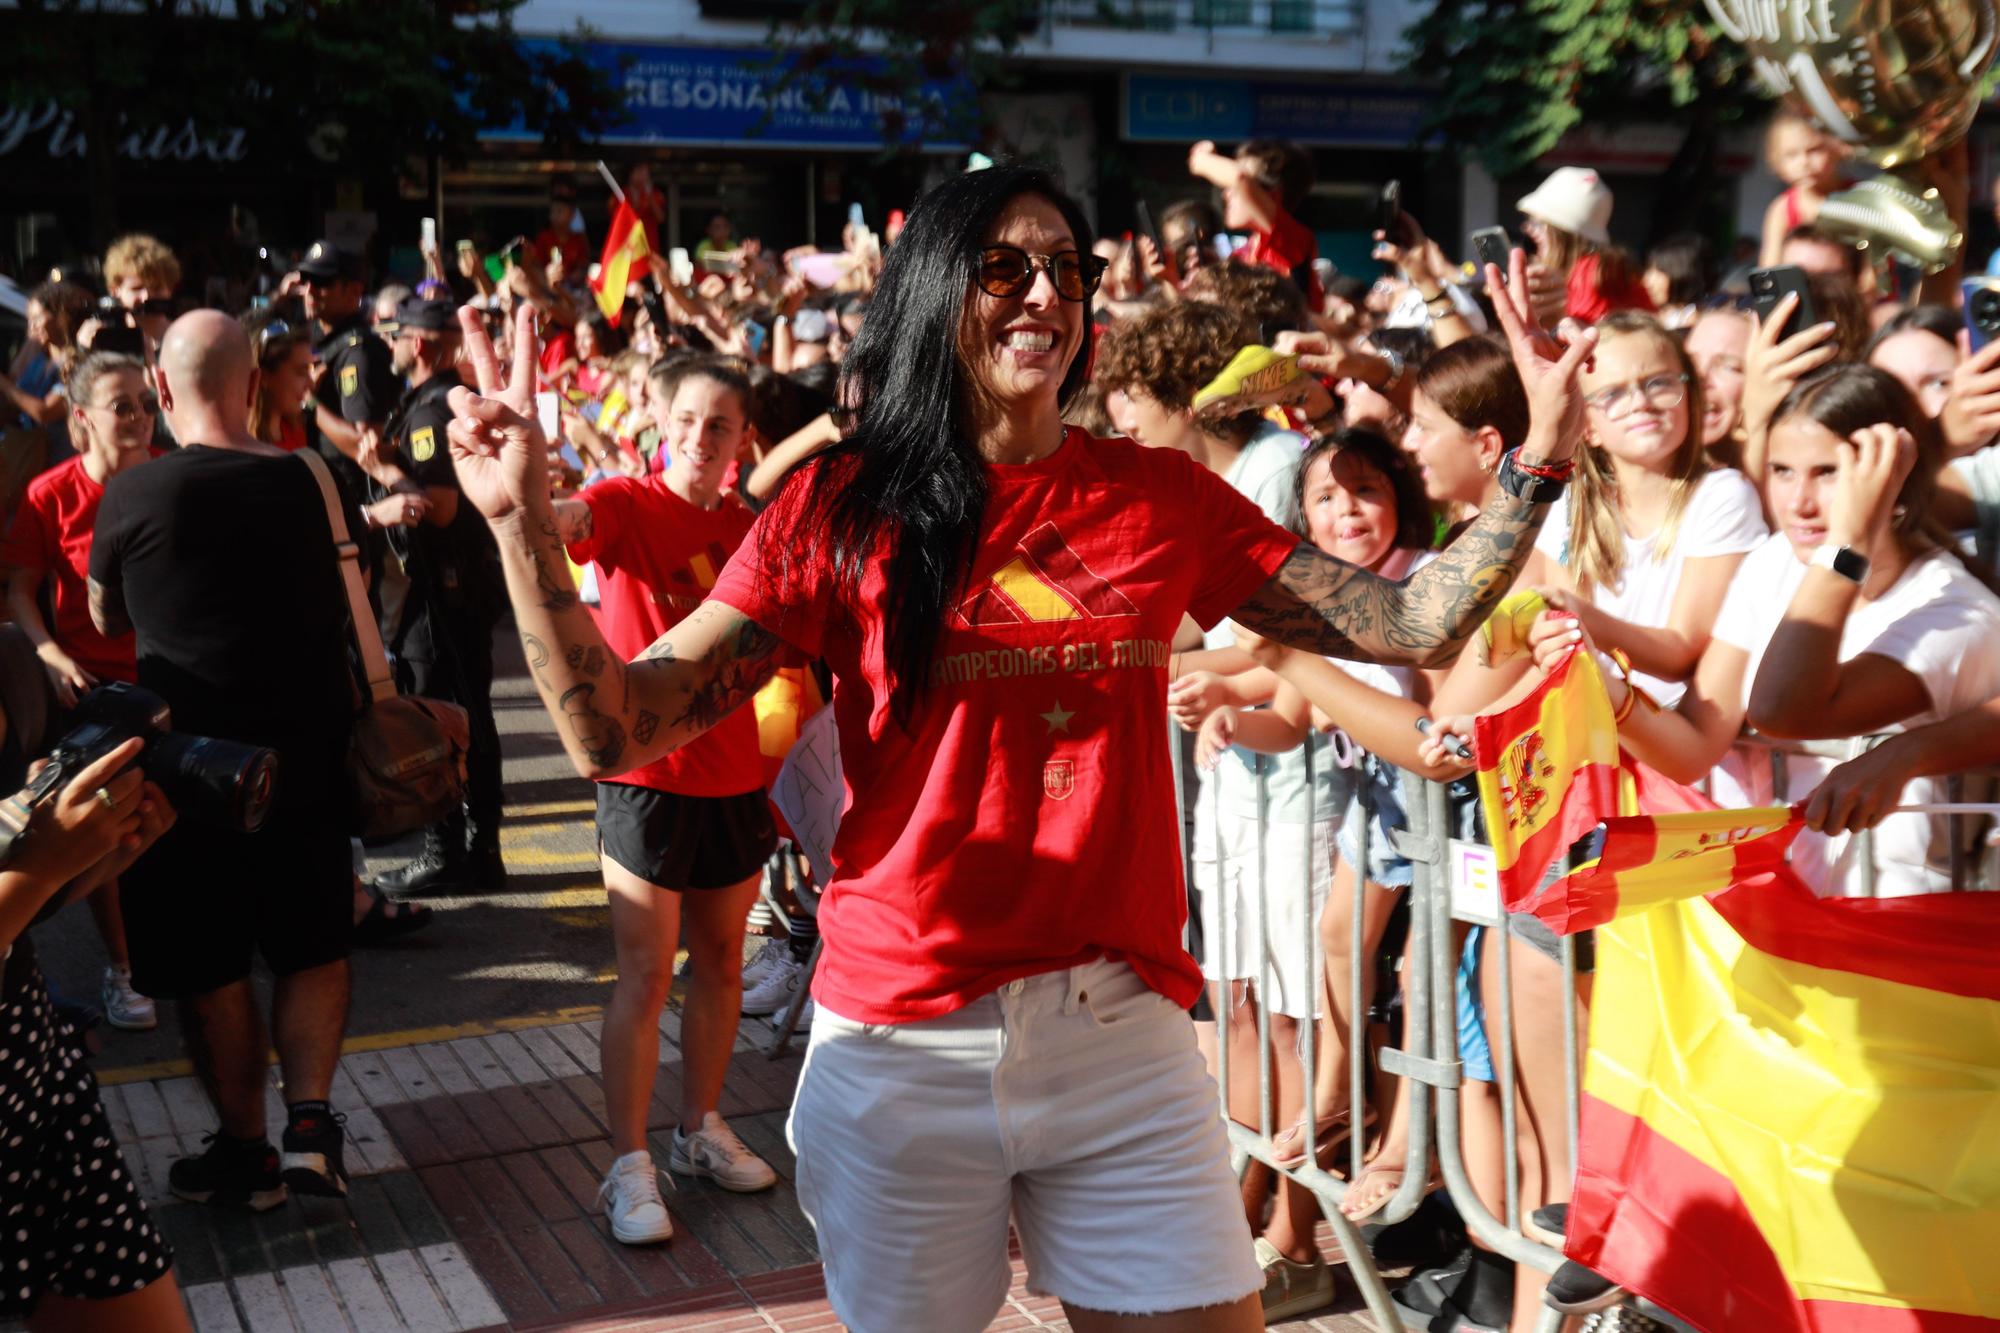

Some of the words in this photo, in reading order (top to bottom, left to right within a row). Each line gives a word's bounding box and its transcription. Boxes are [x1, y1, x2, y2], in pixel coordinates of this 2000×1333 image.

[625, 77, 851, 113] RESONANCA
[1240, 359, 1288, 395] NIKE
[1063, 642, 1106, 673] DEL
